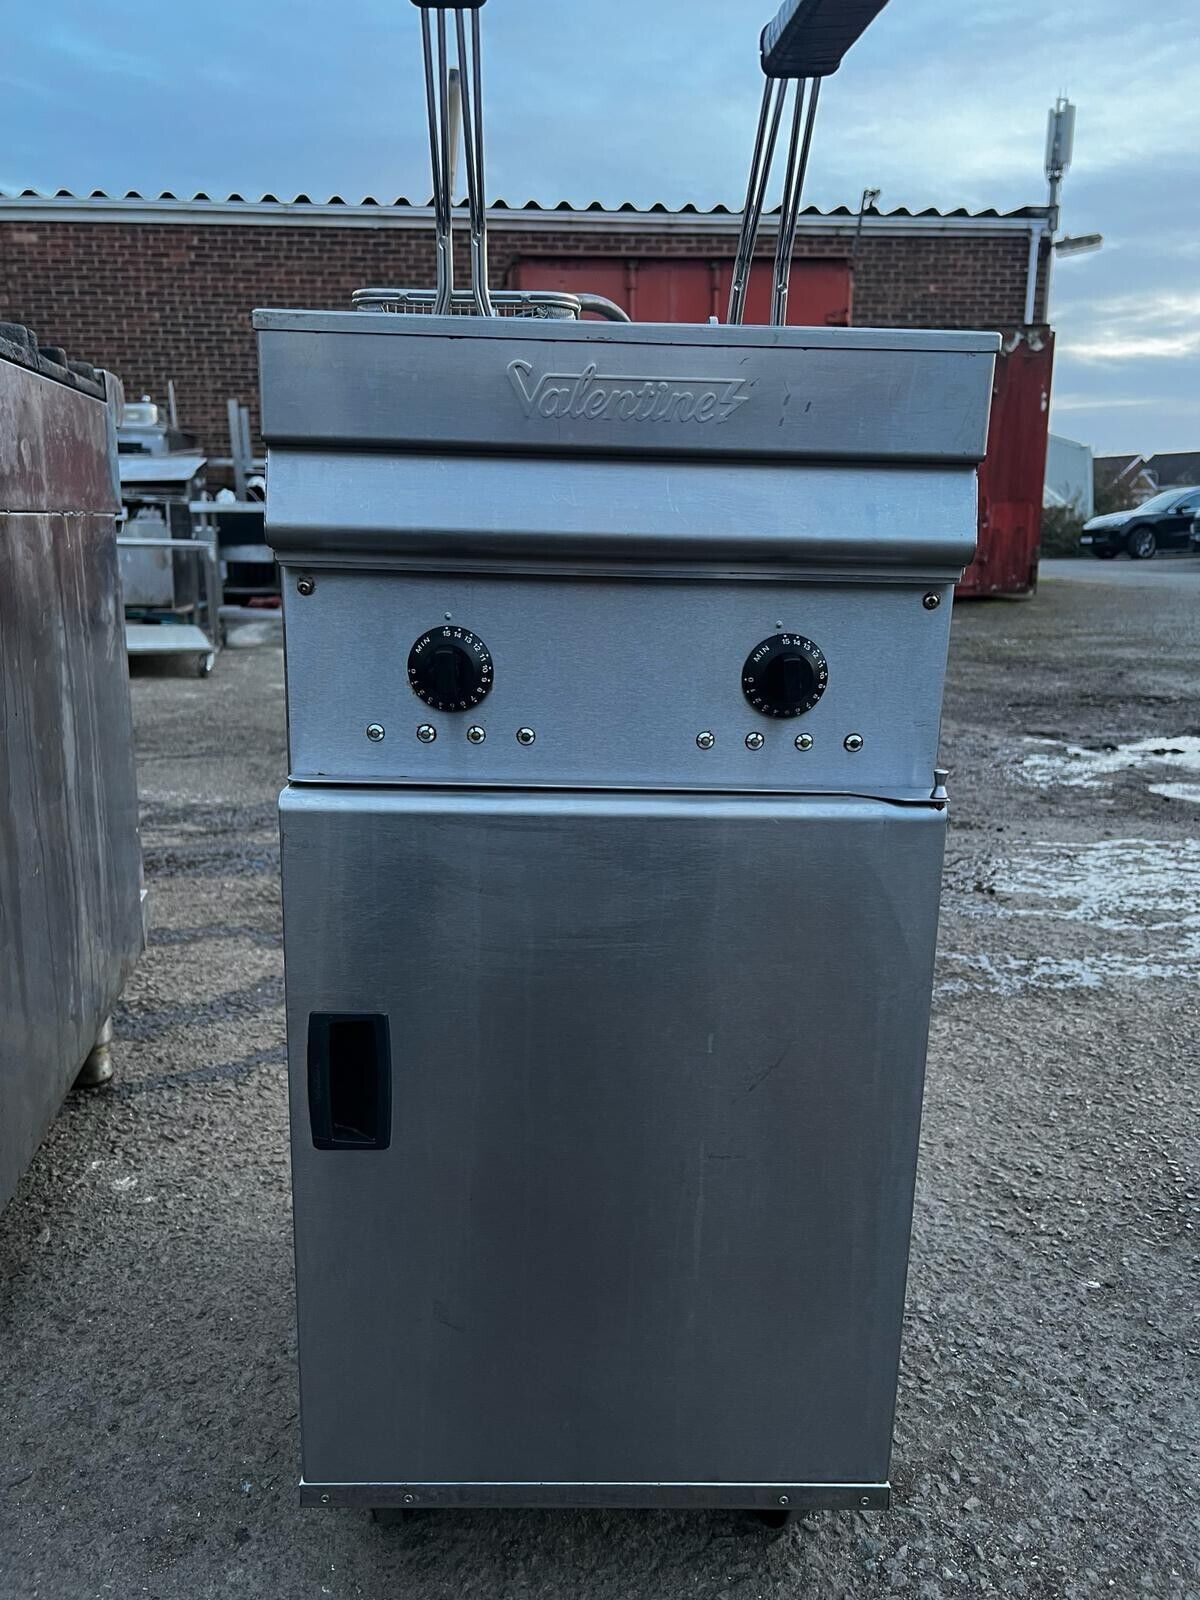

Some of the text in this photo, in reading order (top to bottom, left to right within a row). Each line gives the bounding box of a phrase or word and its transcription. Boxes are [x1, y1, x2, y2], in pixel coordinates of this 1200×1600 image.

[507, 358, 718, 423] Valentine
[416, 637, 430, 653] MIN
[754, 646, 770, 662] MIN
[811, 651, 819, 659] 12
[482, 665, 488, 673] 10
